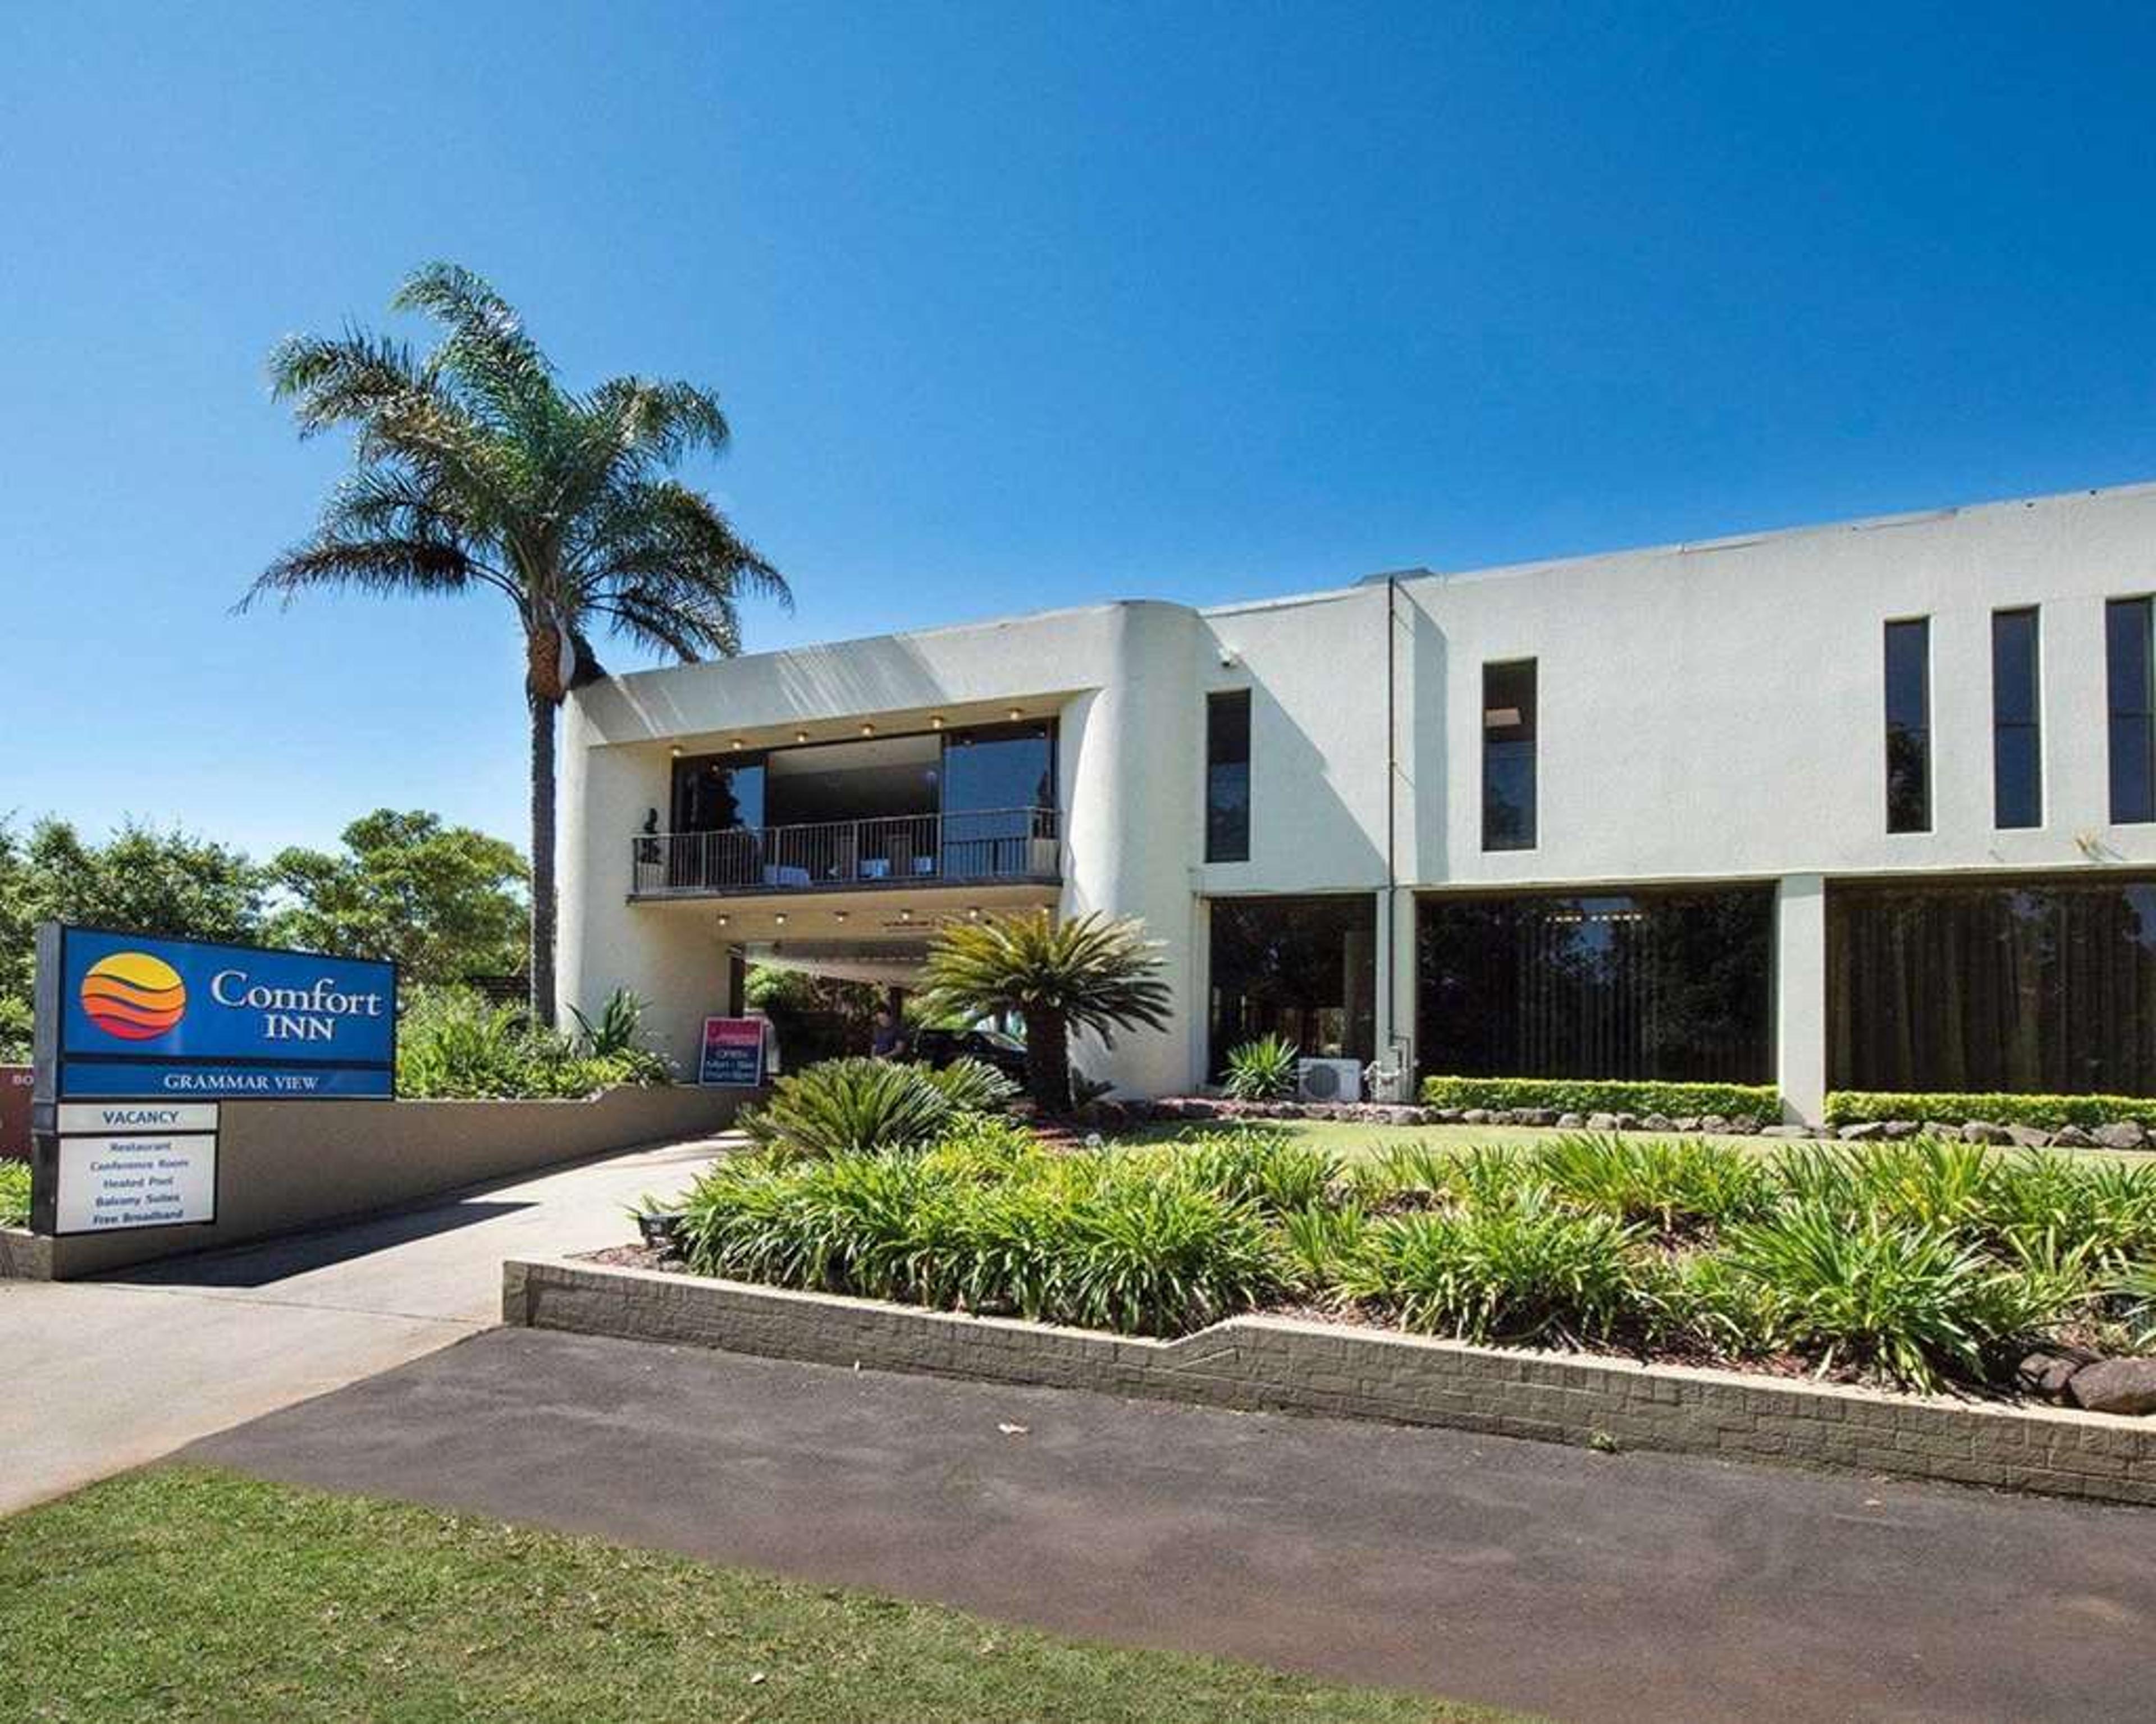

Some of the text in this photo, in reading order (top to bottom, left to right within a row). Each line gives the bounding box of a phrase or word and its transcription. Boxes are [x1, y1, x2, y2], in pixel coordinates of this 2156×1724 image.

[211, 970, 382, 1016] Comfort
[263, 1013, 336, 1041] INN
[164, 1073, 319, 1090] GRAMMAR VIEW
[102, 1111, 180, 1124] VACANCY
[110, 1141, 172, 1151] Restaurant
[90, 1159, 189, 1172] Conference Room
[103, 1176, 174, 1188] Heated Pool
[96, 1193, 180, 1207] Balcony Suites
[93, 1209, 184, 1224] Free Broadband
